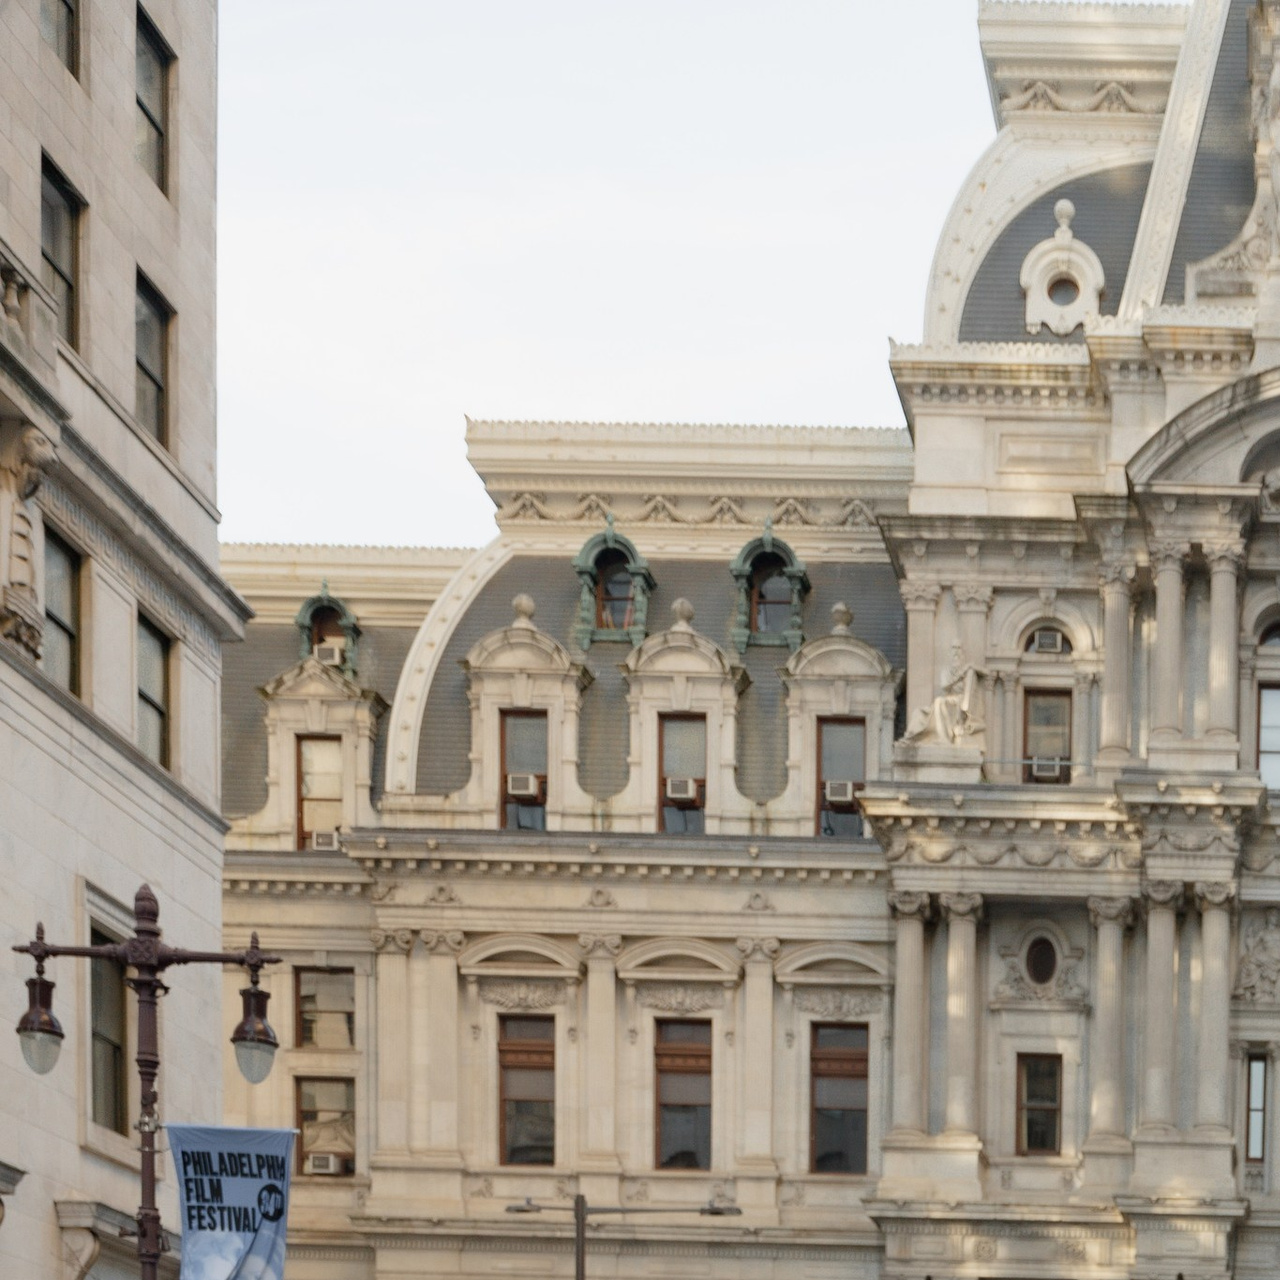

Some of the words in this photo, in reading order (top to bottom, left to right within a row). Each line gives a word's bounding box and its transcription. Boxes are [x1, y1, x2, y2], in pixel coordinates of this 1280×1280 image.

[181, 1150, 286, 1181] PHILADELPHIA
[184, 1178, 223, 1204] FILM
[187, 1205, 258, 1233] FESTIVAL
